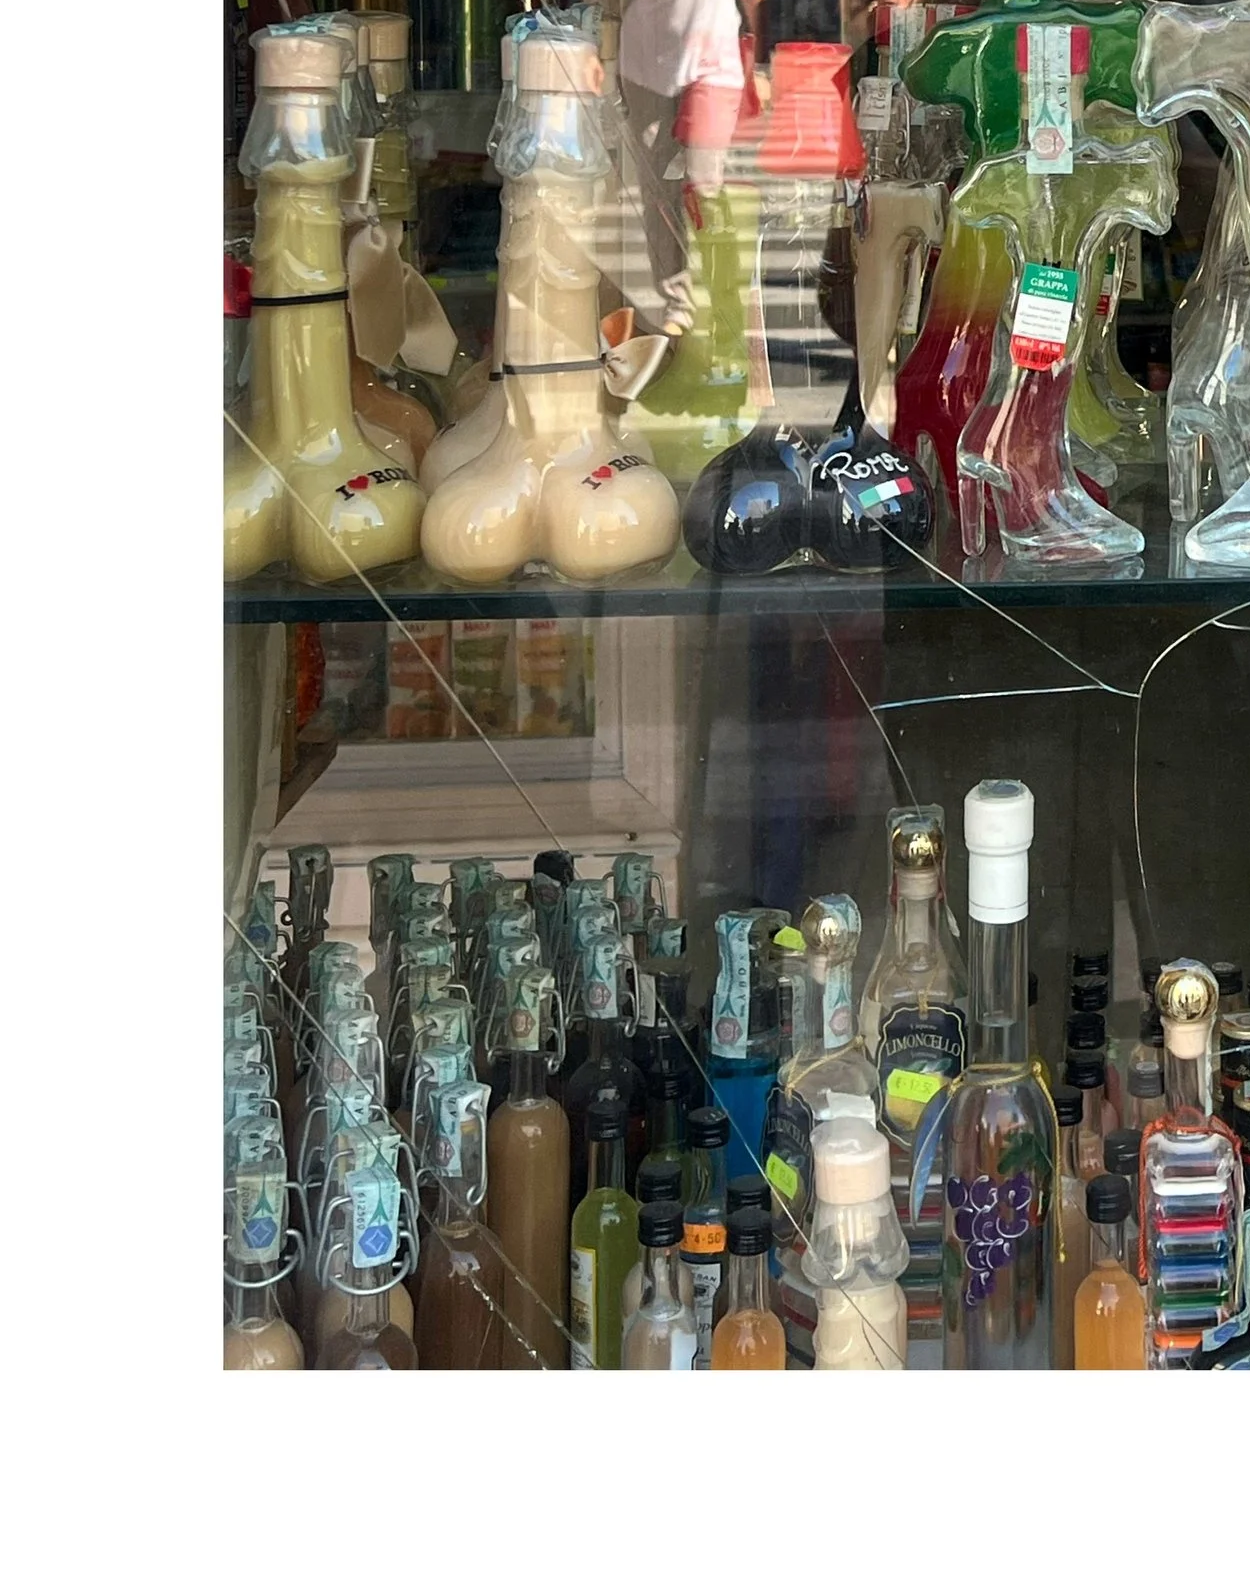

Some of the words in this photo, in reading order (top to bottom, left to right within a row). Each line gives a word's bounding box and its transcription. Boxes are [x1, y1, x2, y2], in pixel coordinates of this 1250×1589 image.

[1030, 277, 1069, 292] GRAPPA
[820, 451, 909, 494] Roma
[581, 477, 602, 490] I
[335, 485, 355, 501] I
[886, 1034, 961, 1057] LIMONCELLO
